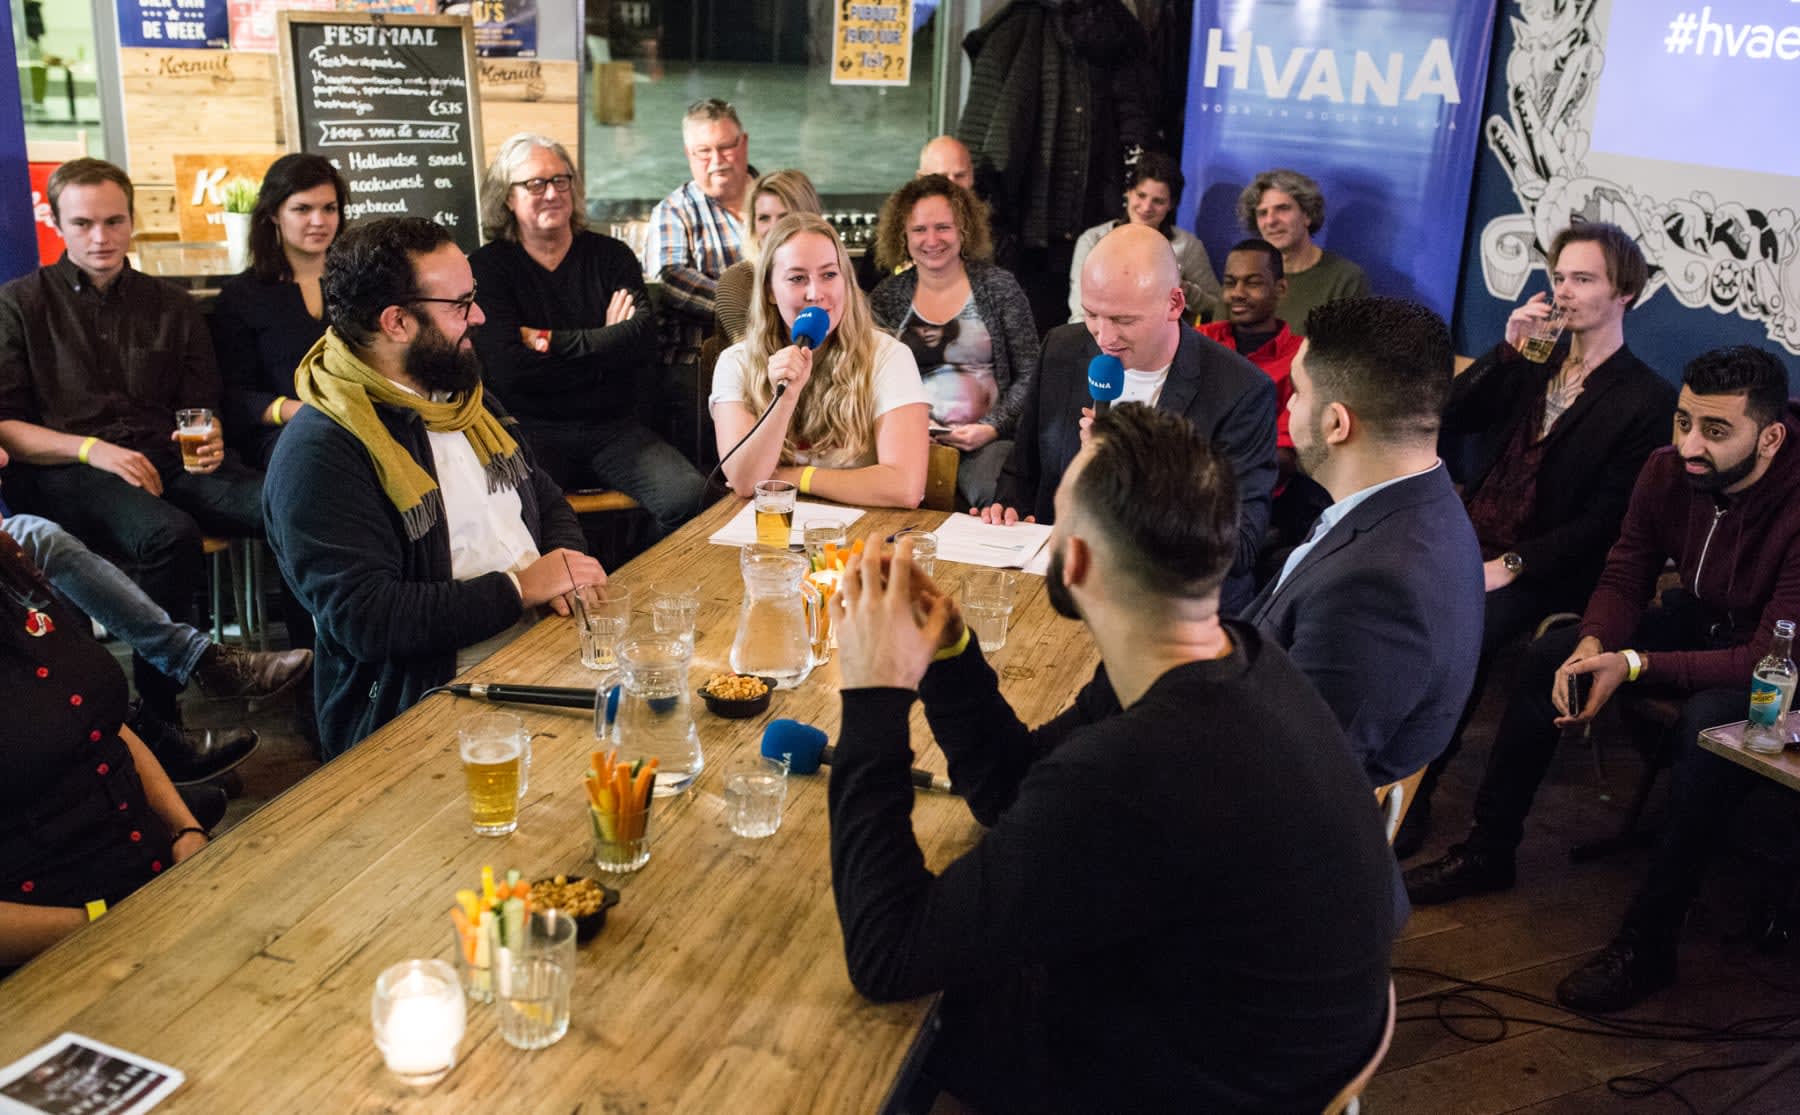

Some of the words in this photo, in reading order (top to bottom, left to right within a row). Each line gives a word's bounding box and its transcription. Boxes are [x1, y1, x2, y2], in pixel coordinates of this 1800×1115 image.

[142, 21, 163, 39] DE
[165, 21, 207, 40] WEEK
[323, 25, 438, 46] FESTMAAL
[1203, 28, 1461, 107] HVANA
[329, 126, 365, 141] soep
[368, 126, 395, 138] van
[397, 123, 412, 138] de
[417, 126, 451, 140] week
[348, 151, 418, 170] Hollandse
[434, 177, 452, 189] en
[344, 197, 408, 220] ggebrood
